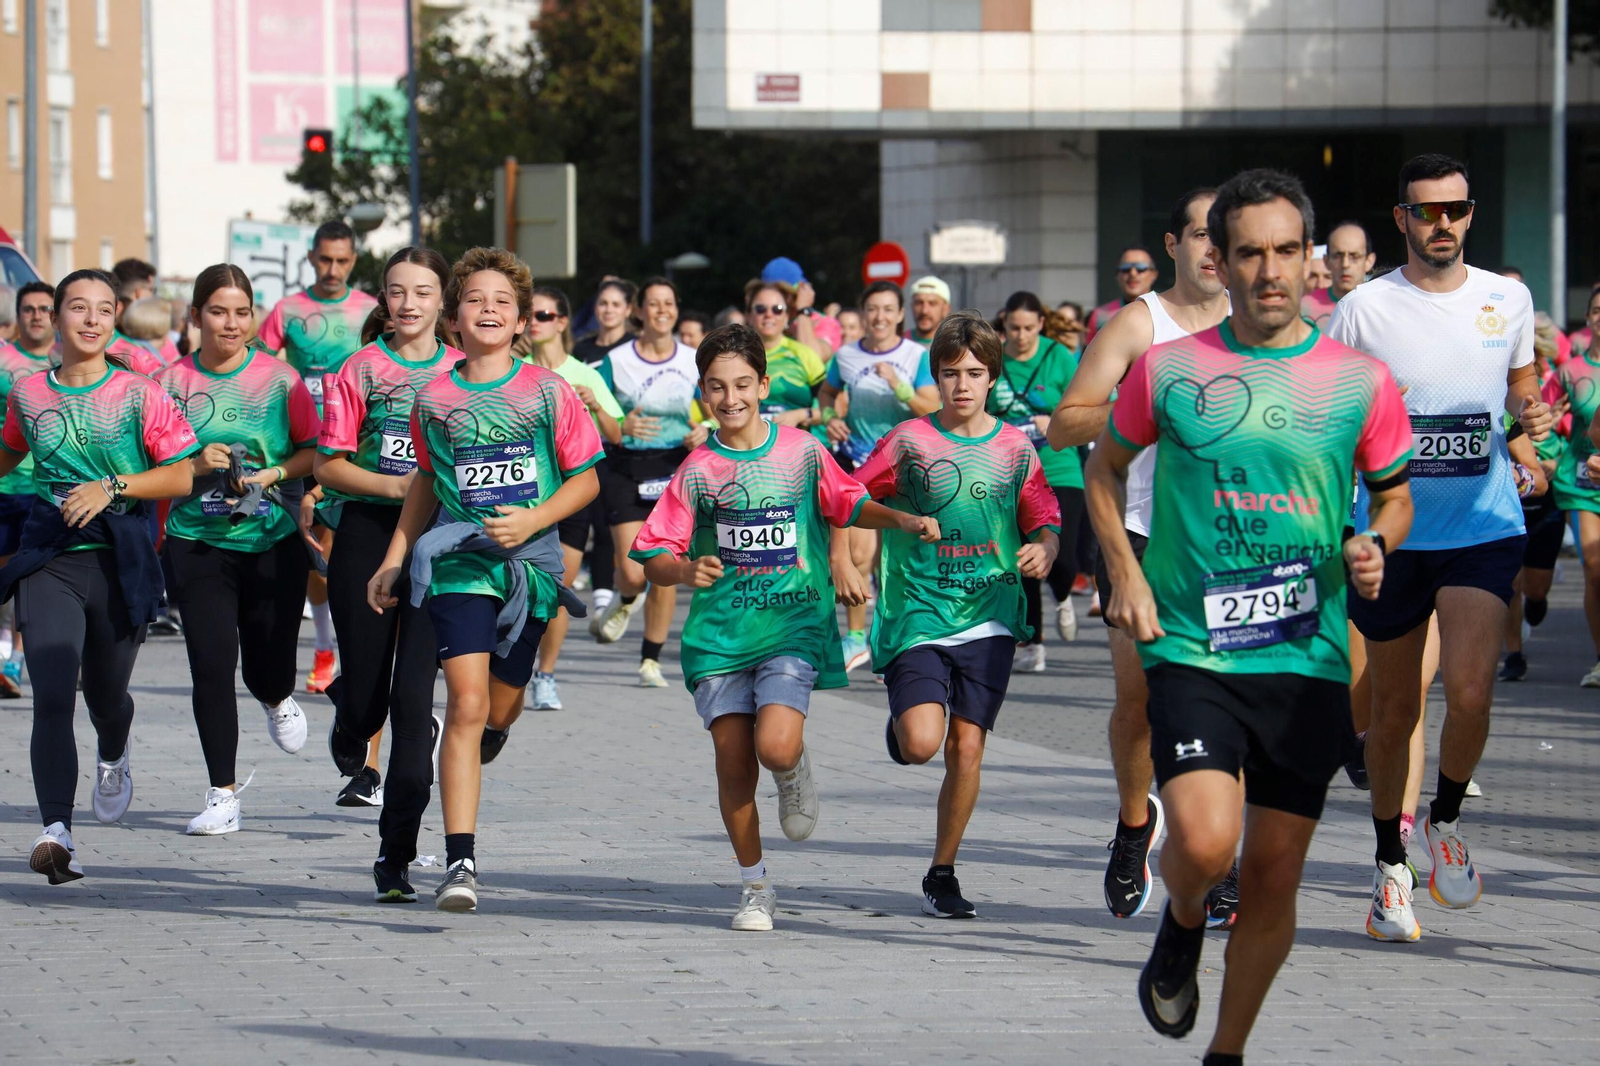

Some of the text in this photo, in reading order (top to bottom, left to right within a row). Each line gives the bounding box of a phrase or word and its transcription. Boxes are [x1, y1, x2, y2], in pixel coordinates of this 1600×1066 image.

[1420, 435, 1481, 456] 2036
[465, 462, 524, 487] 2276
[1214, 461, 1247, 485] La
[470, 493, 500, 503] engancha
[1214, 489, 1319, 515] marcha
[1214, 513, 1268, 538] que
[727, 527, 785, 548] 1940
[1215, 538, 1334, 565] engancha
[937, 560, 976, 576] que
[731, 585, 821, 610] engancha
[733, 579, 775, 596] que
[1222, 586, 1300, 622] 2794
[1228, 626, 1259, 636] marcha
[1230, 632, 1271, 644] engancha
